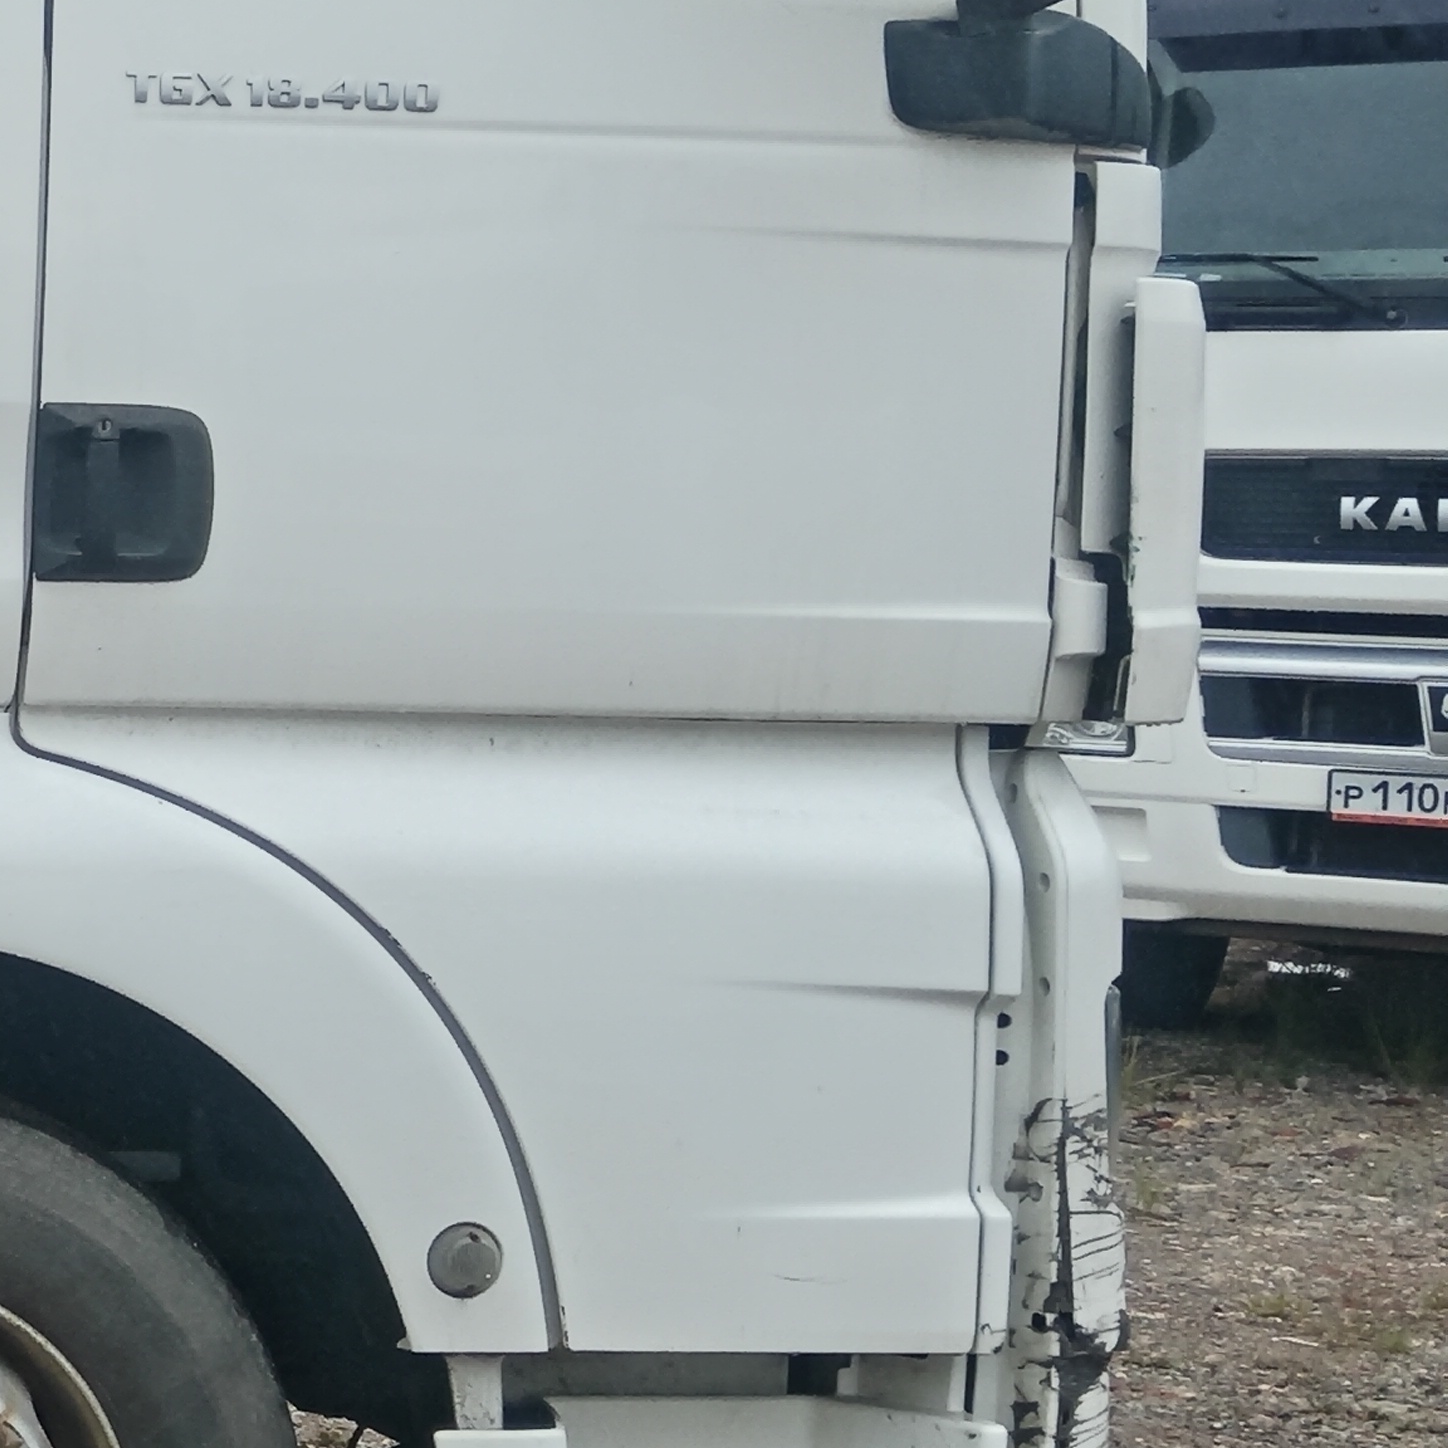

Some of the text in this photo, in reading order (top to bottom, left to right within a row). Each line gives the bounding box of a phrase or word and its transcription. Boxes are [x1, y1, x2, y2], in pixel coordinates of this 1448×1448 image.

[125, 70, 441, 113] TGX 18.400
[1339, 496, 1448, 532] KA
[1343, 780, 1448, 815] P110
